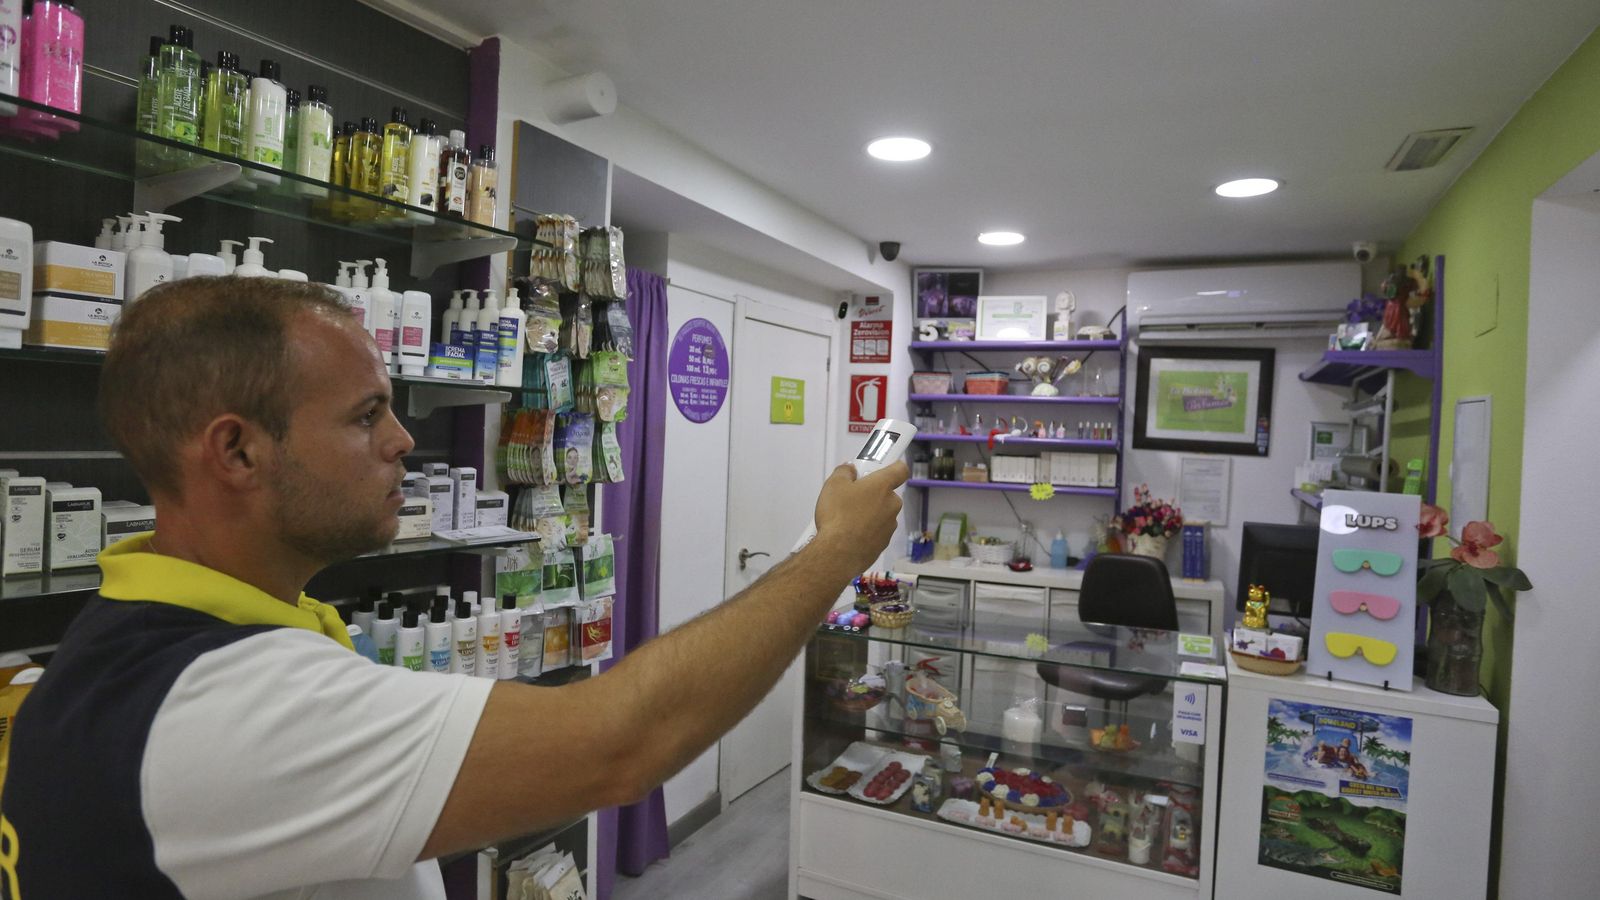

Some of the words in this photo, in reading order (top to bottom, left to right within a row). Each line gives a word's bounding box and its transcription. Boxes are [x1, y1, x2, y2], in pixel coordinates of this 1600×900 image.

[859, 321, 885, 329] Alarma
[692, 333, 713, 345] PERFUMES
[670, 374, 689, 384] COLONIAS
[690, 376, 706, 386] FRESCAS
[1345, 513, 1398, 531] LUPS
[1180, 728, 1198, 737] VISA
